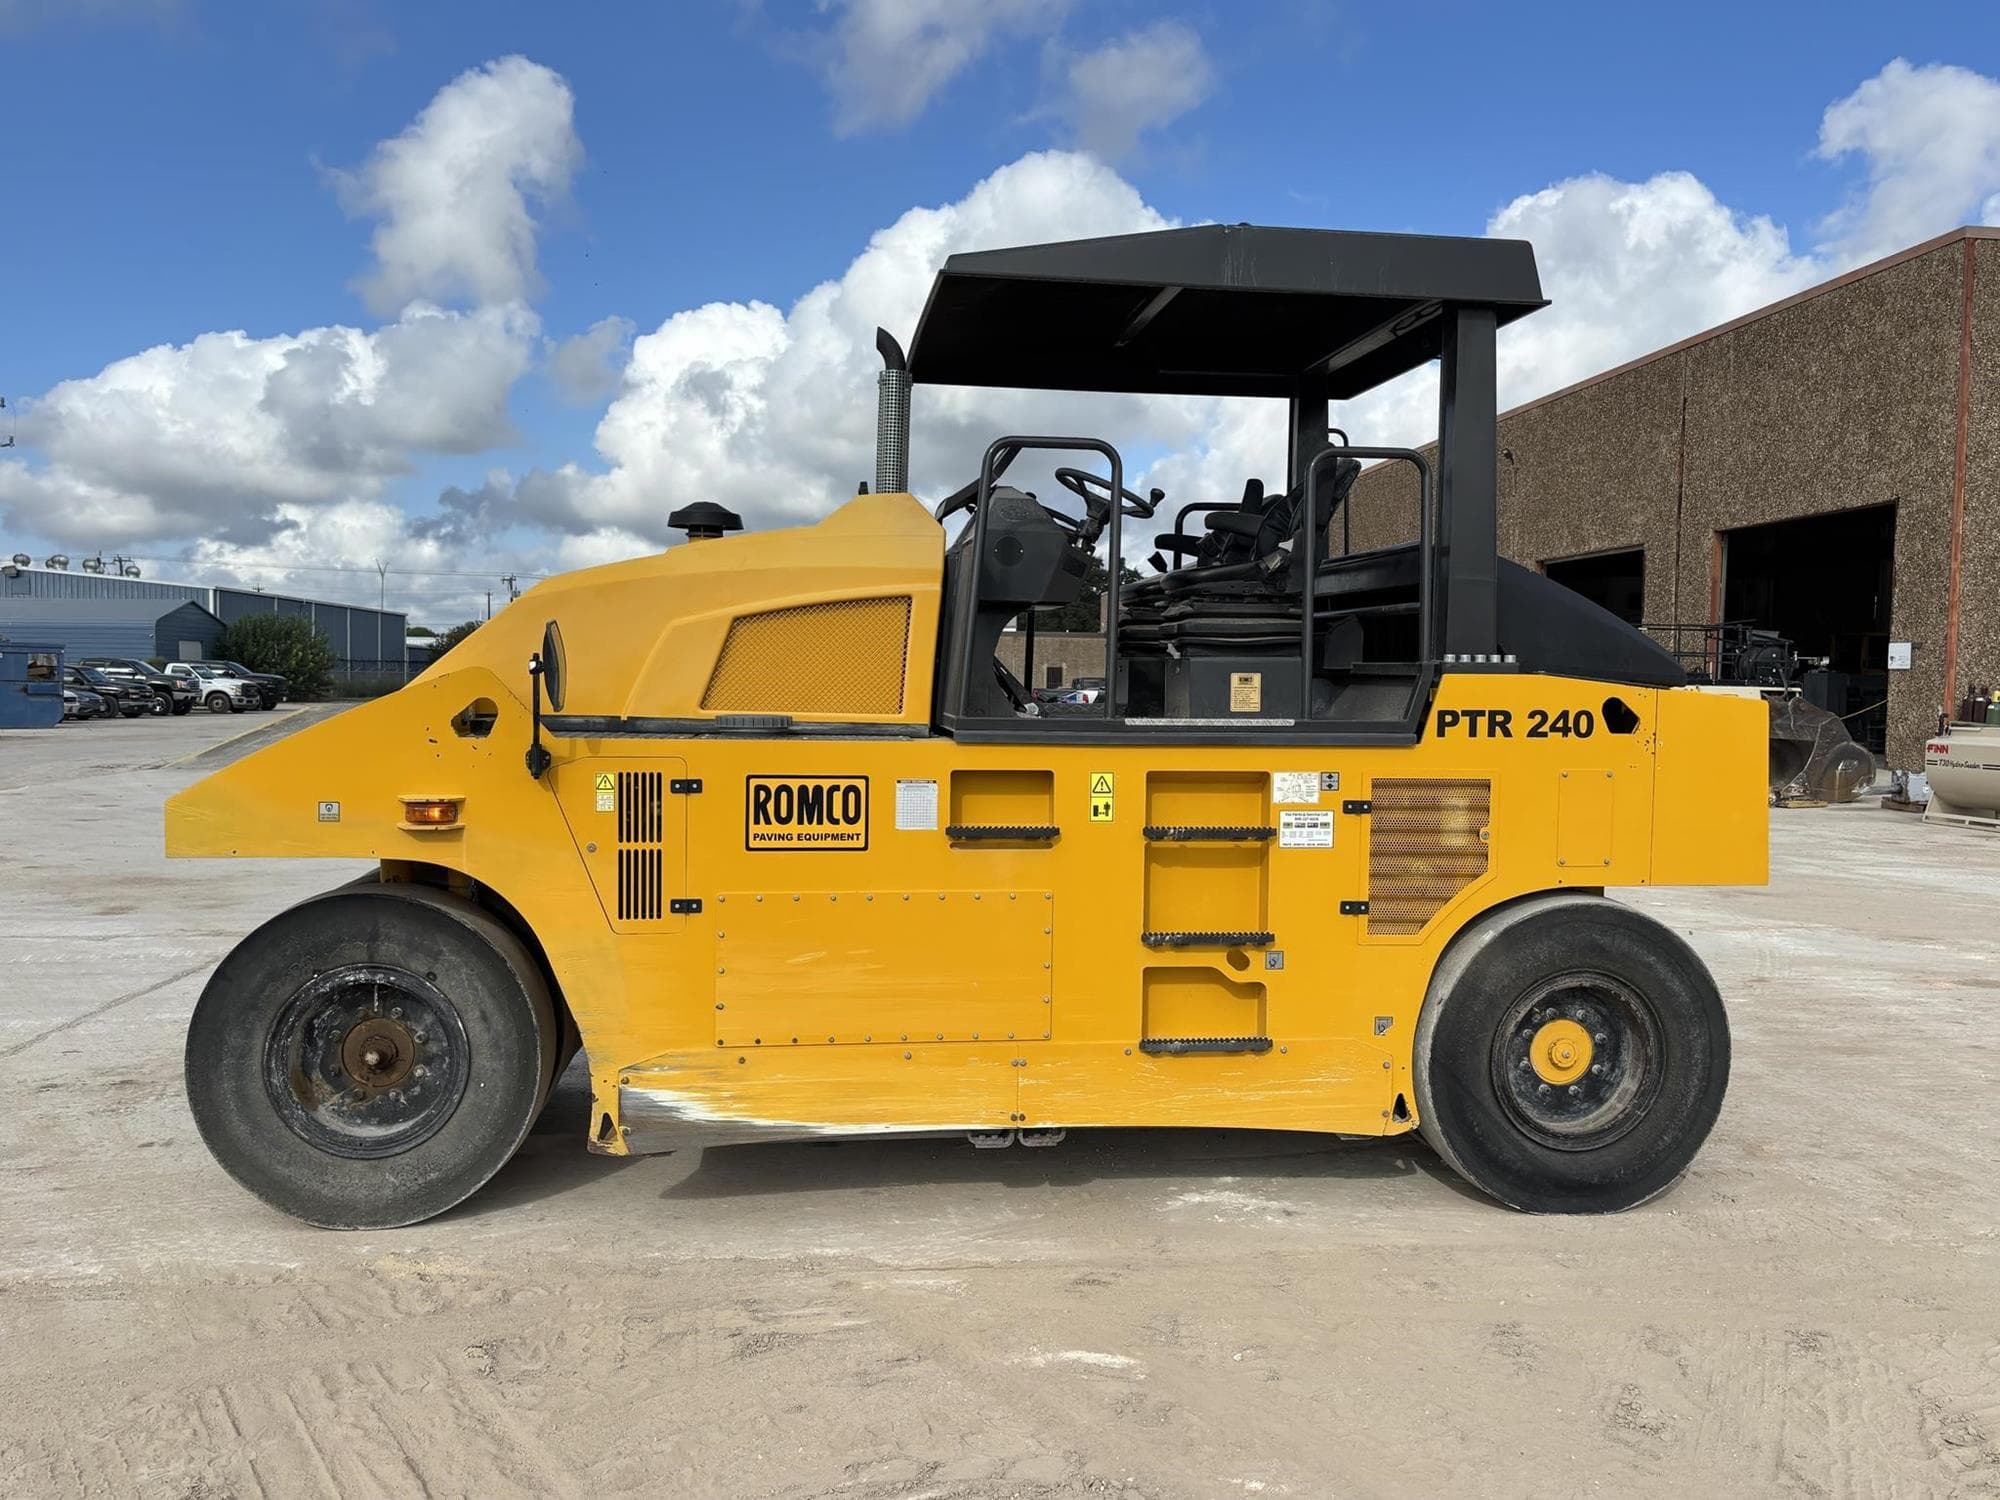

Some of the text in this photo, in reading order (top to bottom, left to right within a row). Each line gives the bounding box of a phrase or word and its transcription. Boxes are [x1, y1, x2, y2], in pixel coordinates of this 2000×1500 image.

[1436, 710, 1594, 738] PTR 240
[1927, 744, 1949, 754] FINN
[753, 784, 861, 825] ROMCO
[753, 833, 861, 842] PAVING EQUIPMENT
